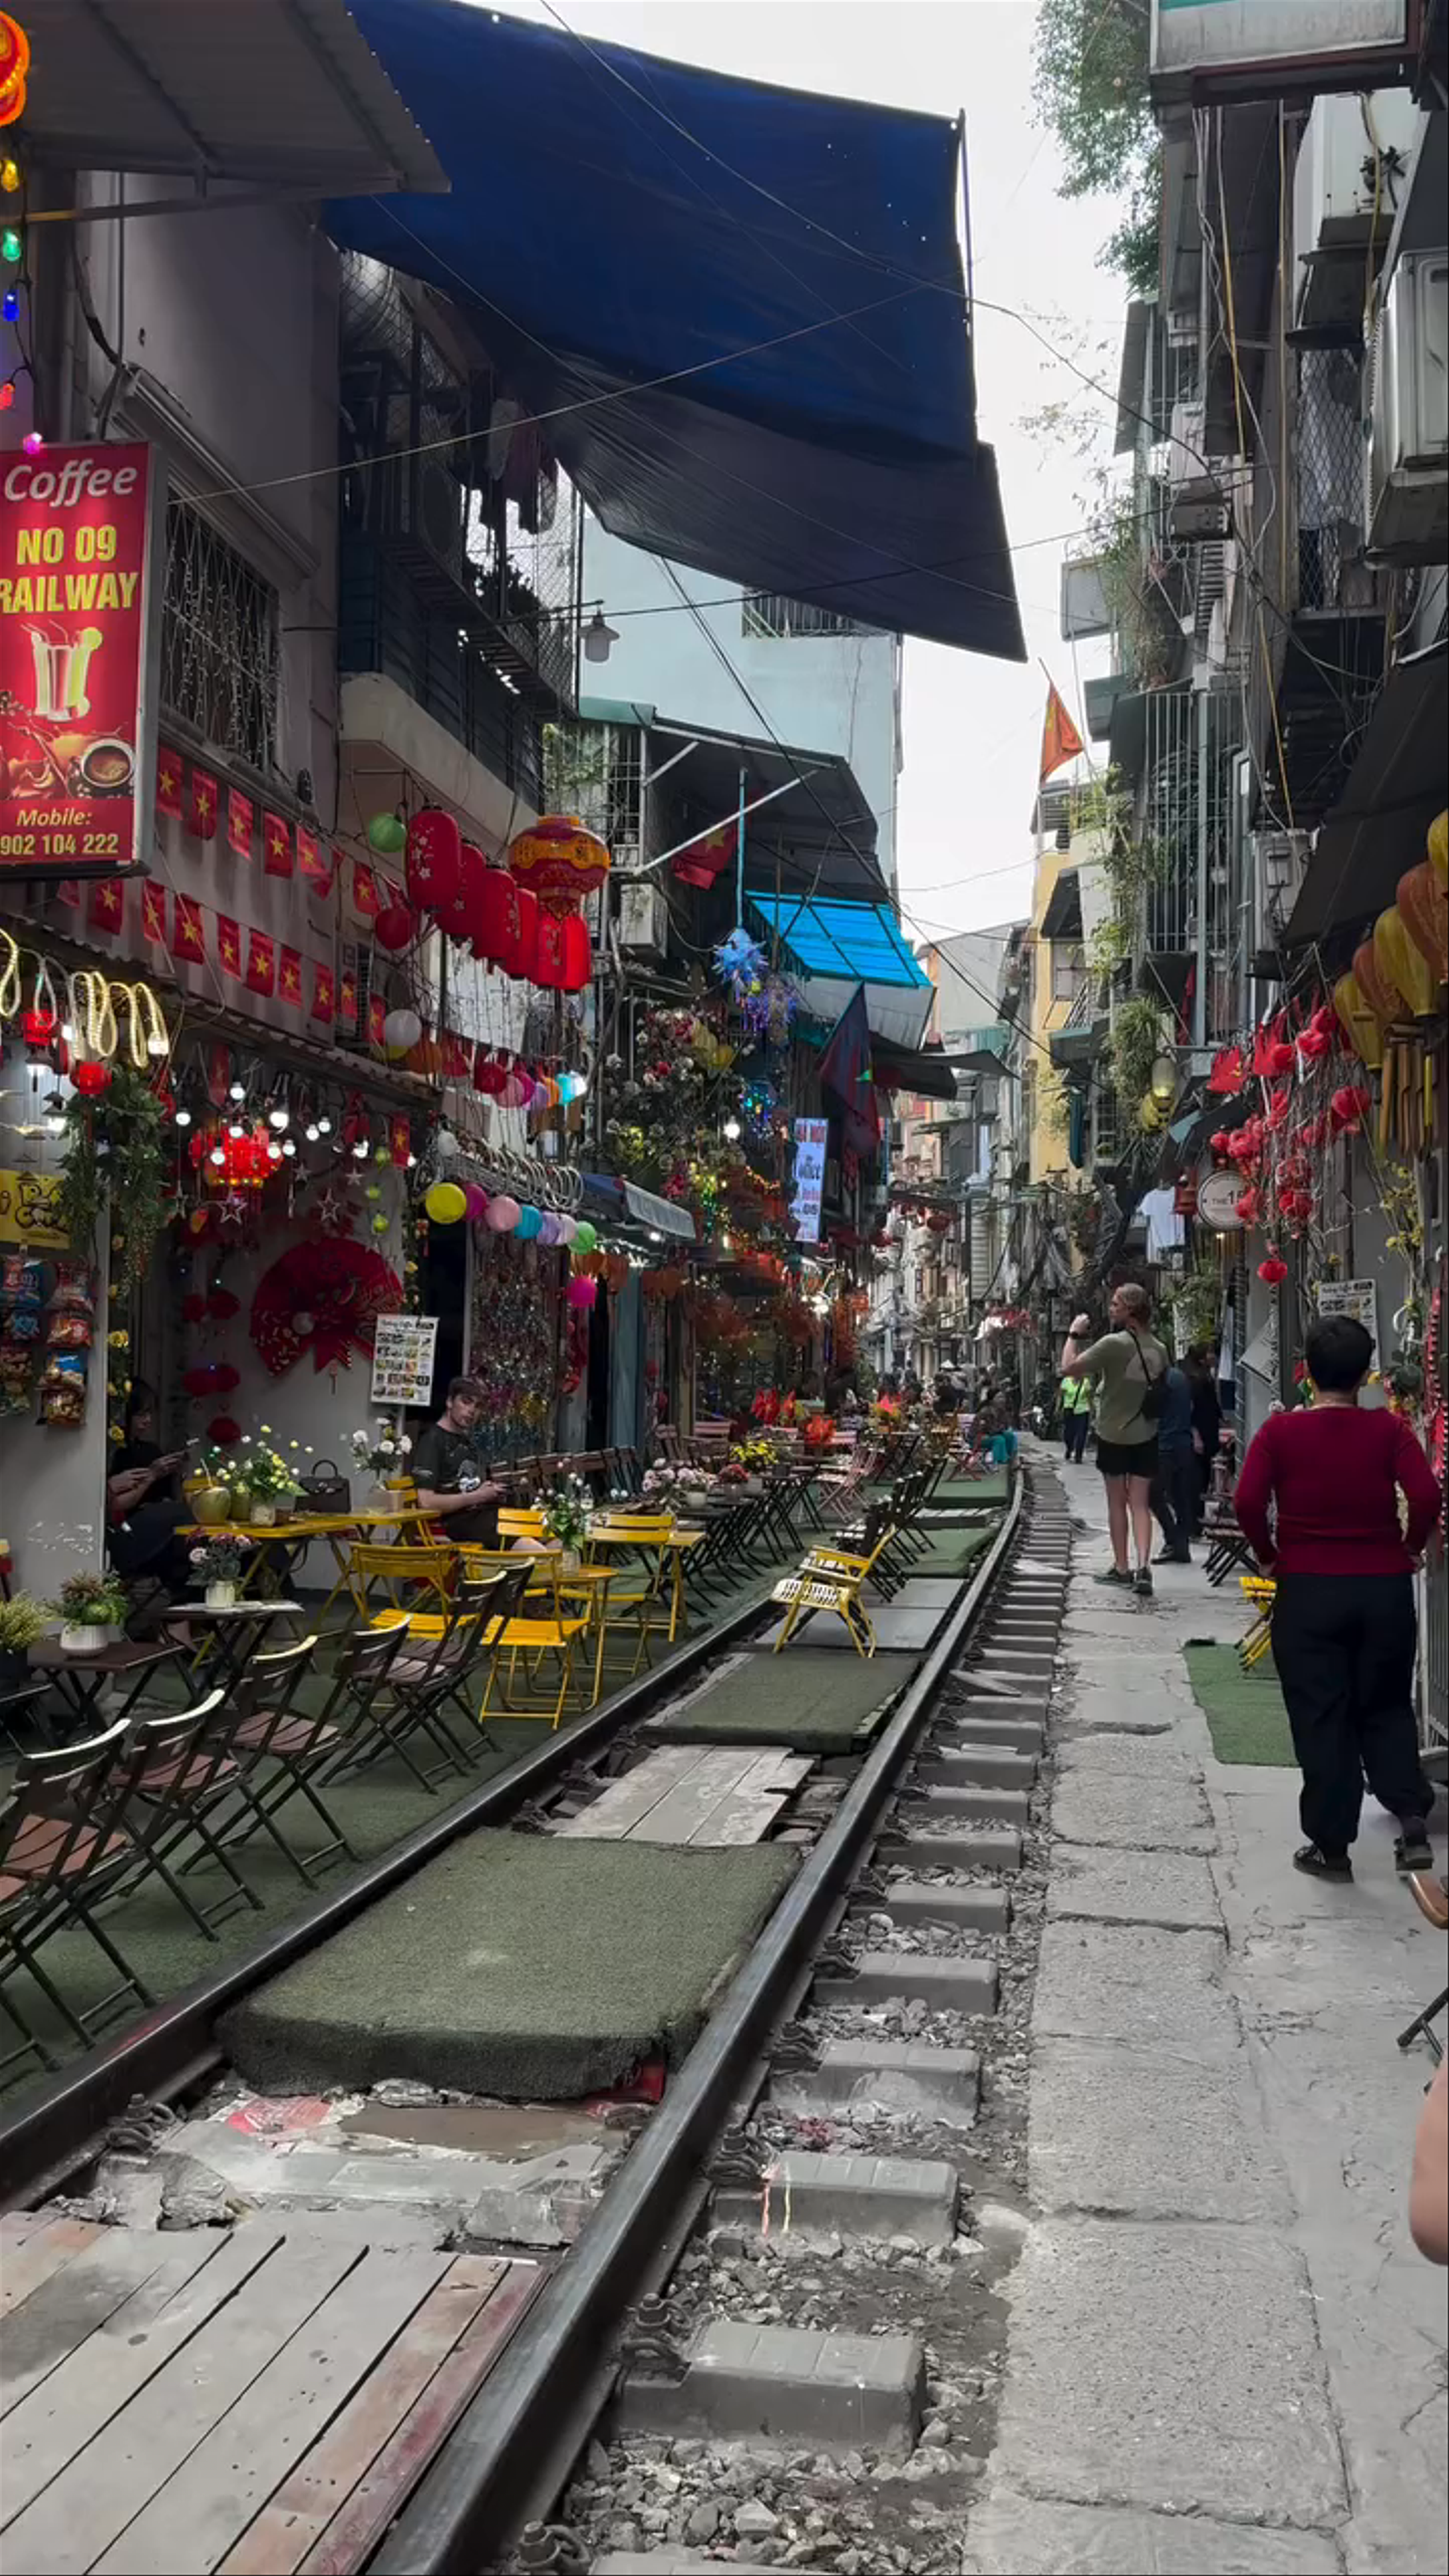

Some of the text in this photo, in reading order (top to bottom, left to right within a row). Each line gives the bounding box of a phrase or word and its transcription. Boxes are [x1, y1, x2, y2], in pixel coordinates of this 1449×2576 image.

[5, 458, 137, 507] Coffee
[17, 524, 117, 565] NO 09
[0, 572, 138, 614] RAILWAY
[17, 807, 92, 827] Mobile:
[42, 834, 76, 855] 104
[82, 833, 119, 854] 222
